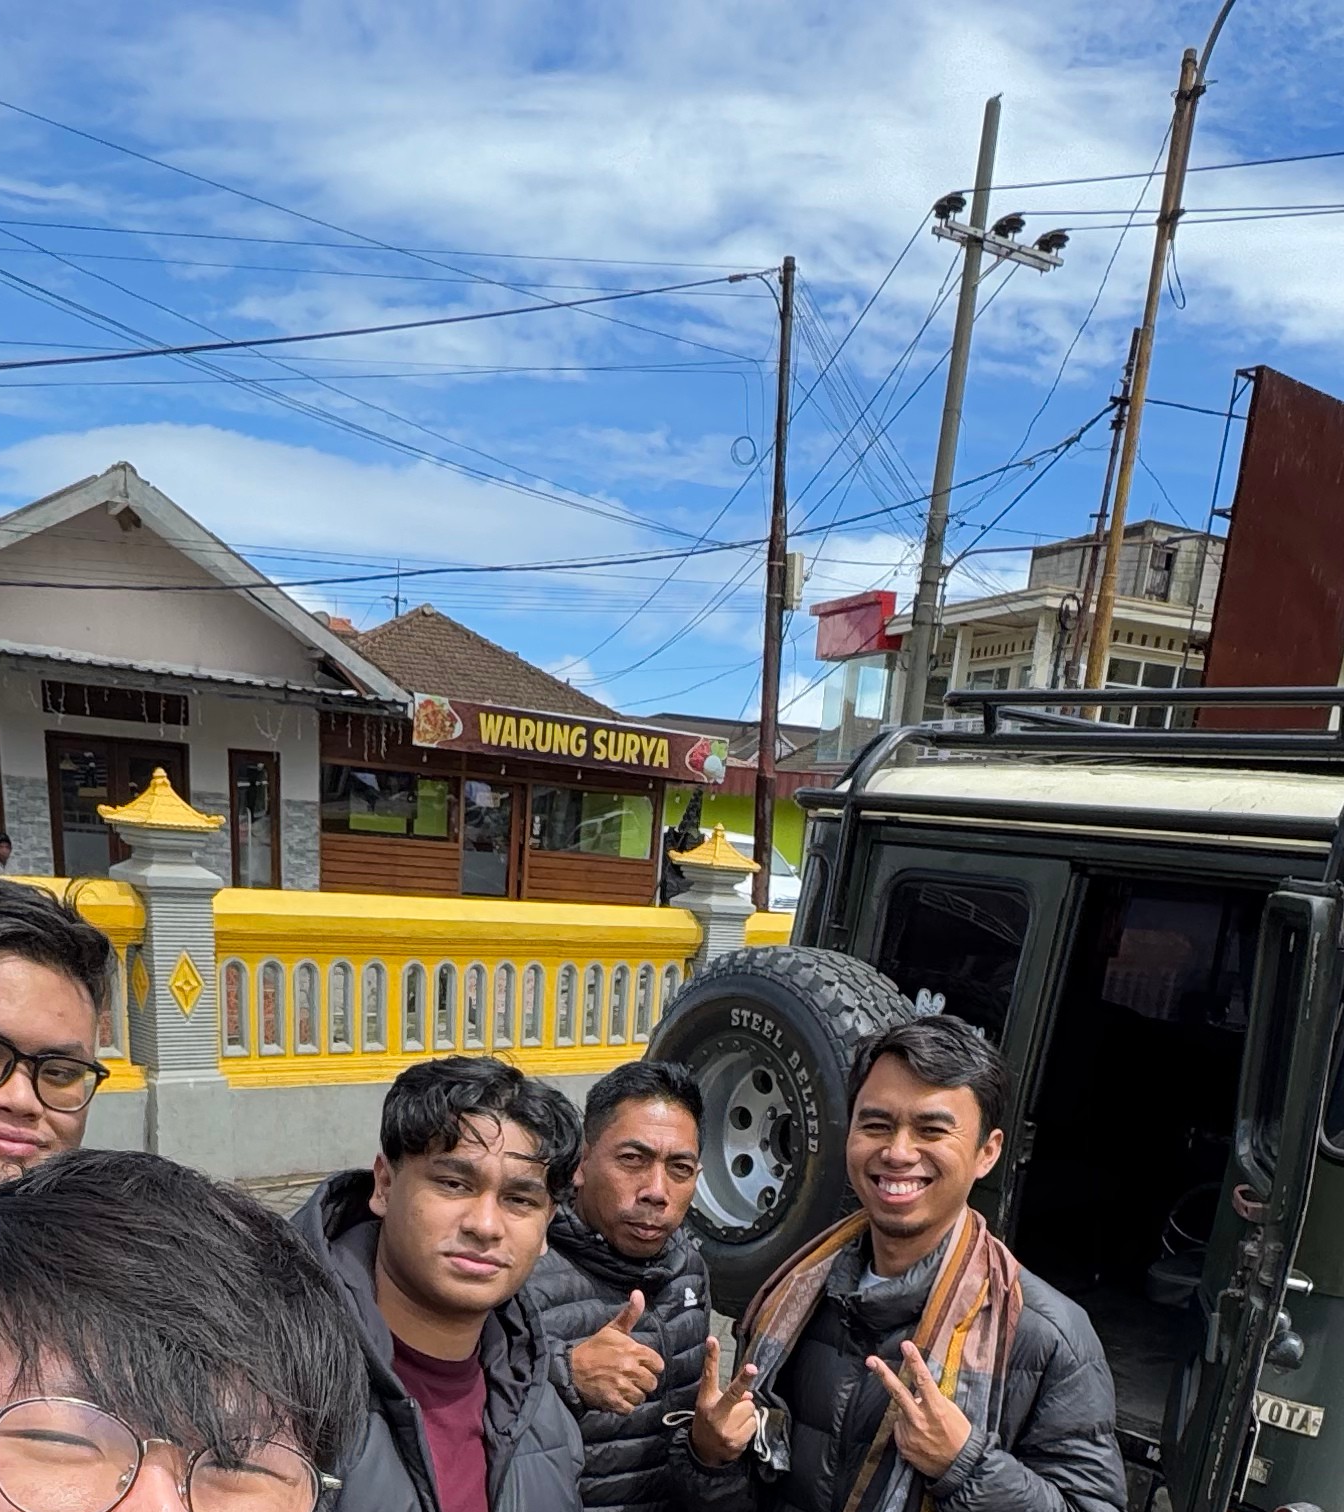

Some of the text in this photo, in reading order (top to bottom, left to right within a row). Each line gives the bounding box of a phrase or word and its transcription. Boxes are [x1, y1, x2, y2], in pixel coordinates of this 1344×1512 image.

[479, 712, 670, 769] WARUNG SURYA
[730, 1008, 820, 1153] STEEL BELTED
[1256, 1395, 1313, 1433] YOTA
